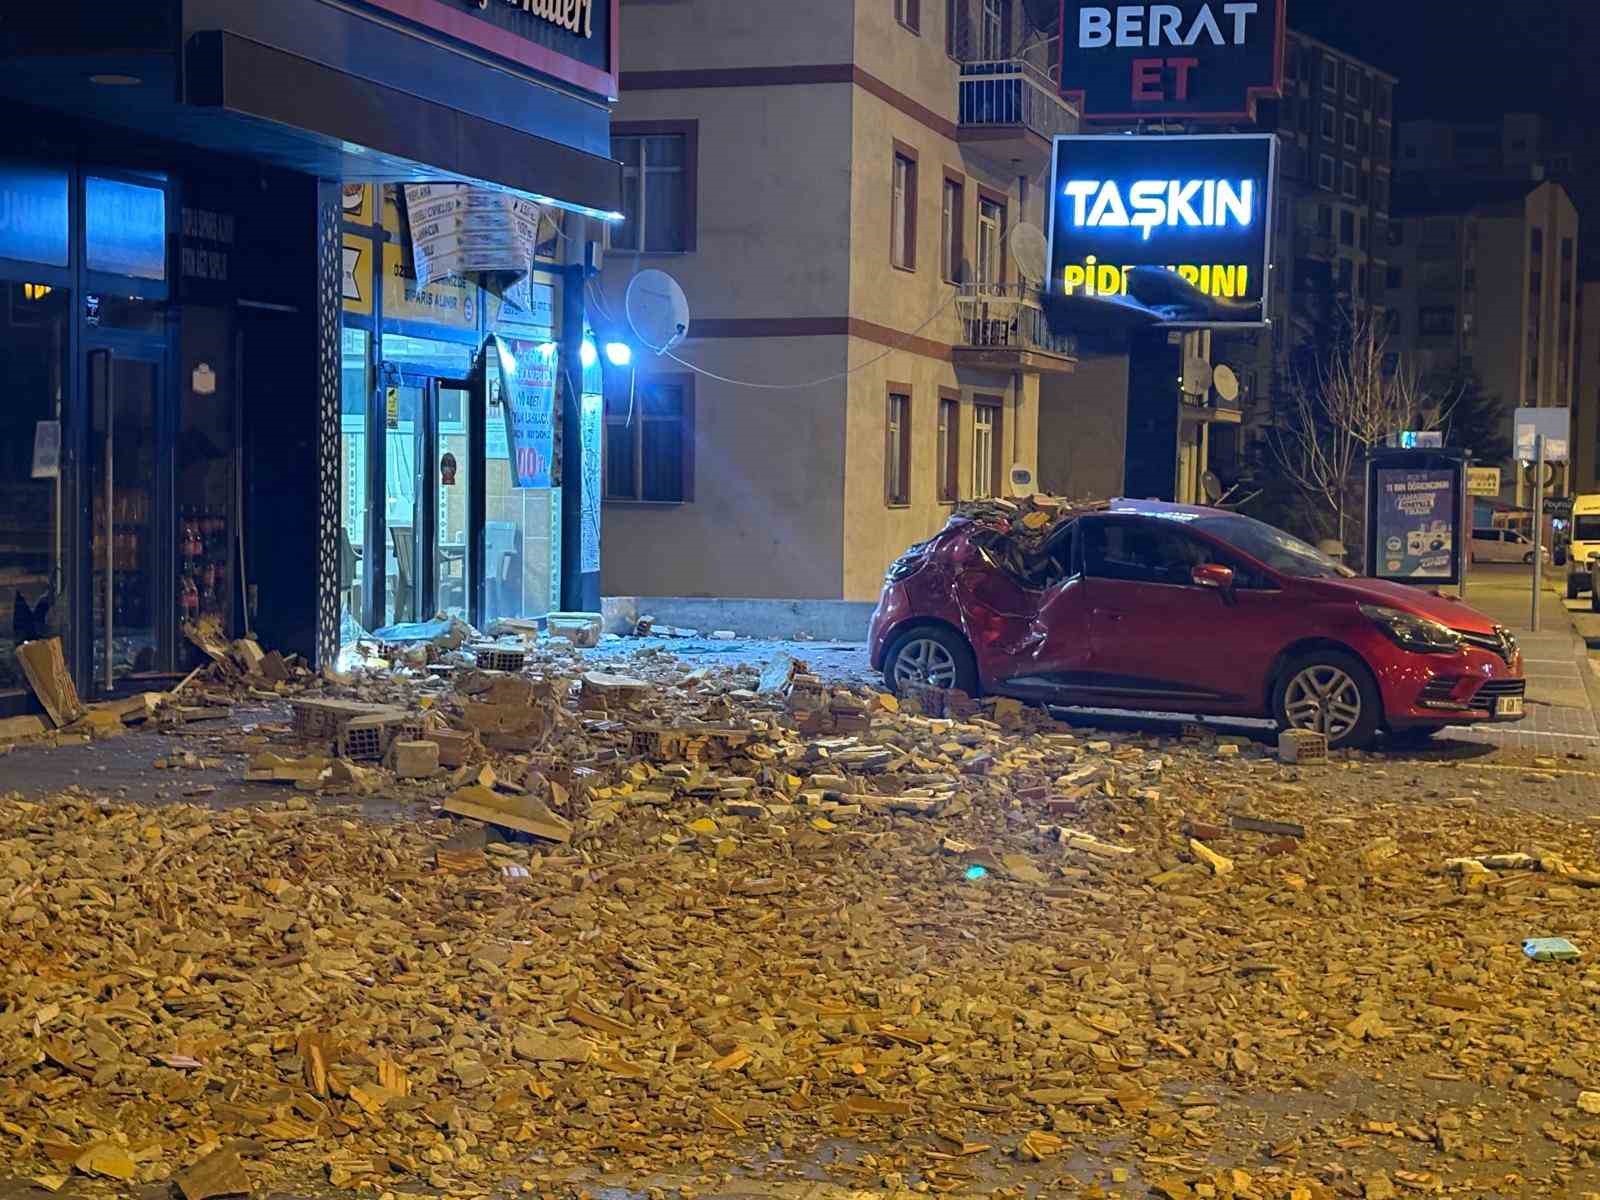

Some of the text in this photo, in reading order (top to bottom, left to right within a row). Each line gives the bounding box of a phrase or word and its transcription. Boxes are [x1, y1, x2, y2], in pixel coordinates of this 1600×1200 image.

[1078, 3, 1257, 48] BERAT
[1132, 58, 1197, 101] ET
[1064, 179, 1253, 240] TAŞKIN
[1159, 264, 1248, 297] RINI
